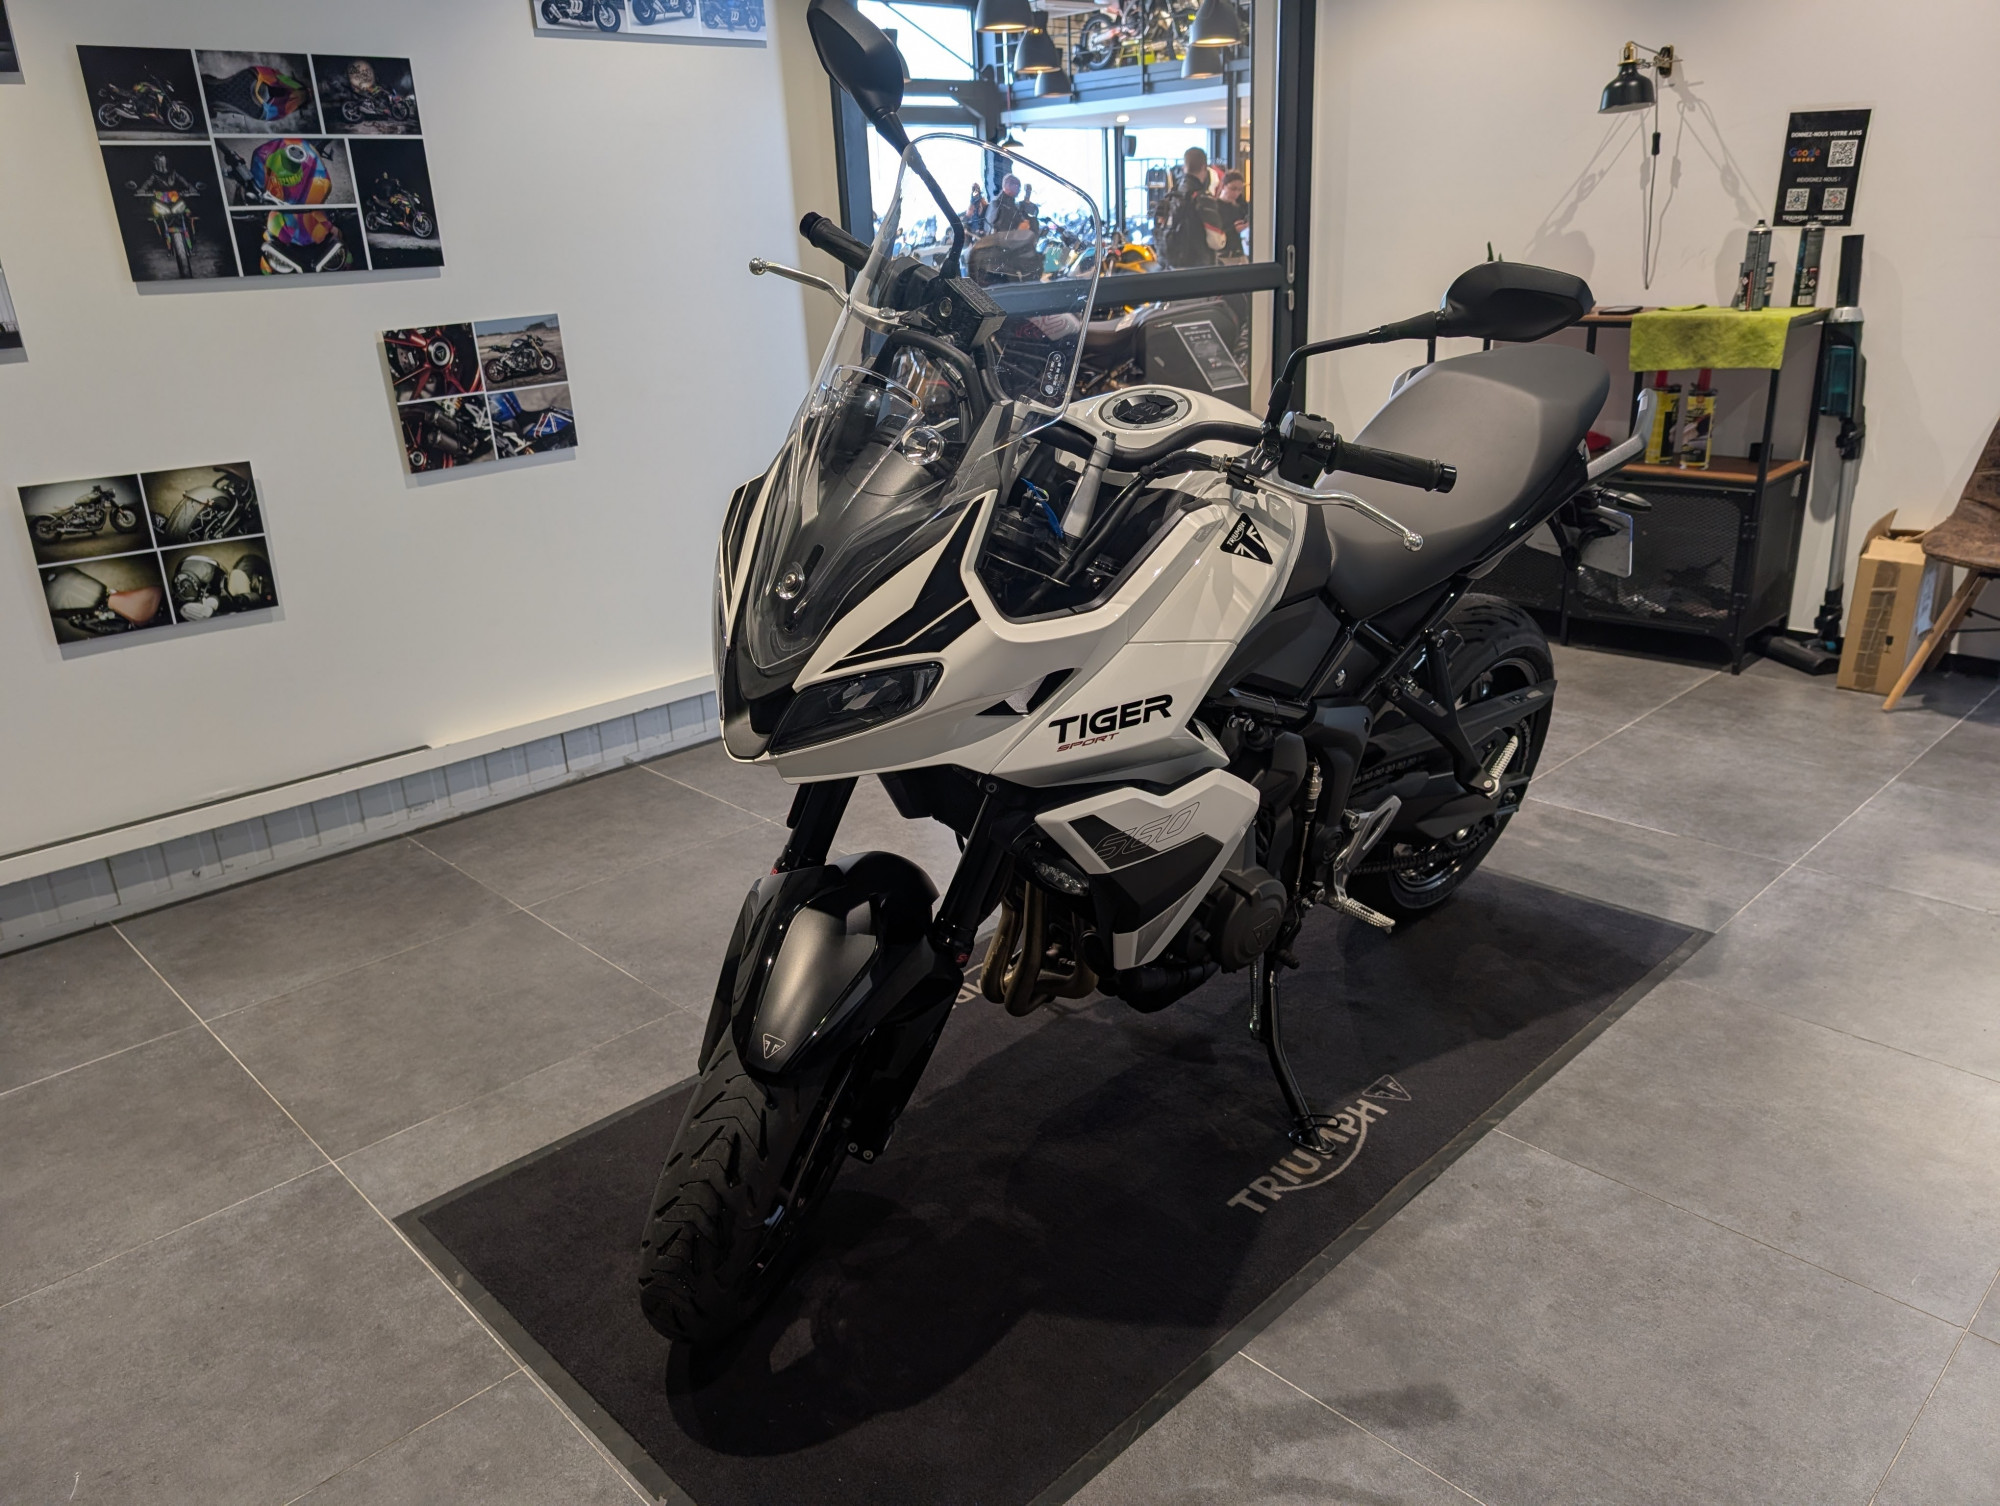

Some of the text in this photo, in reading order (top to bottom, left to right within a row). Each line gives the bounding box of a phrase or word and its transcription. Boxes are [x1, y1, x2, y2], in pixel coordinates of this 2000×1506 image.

[1226, 520, 1247, 547] TRIUMPH
[1048, 694, 1173, 744] TIGER
[1056, 732, 1120, 752] SPORT
[1092, 801, 1201, 861] 660
